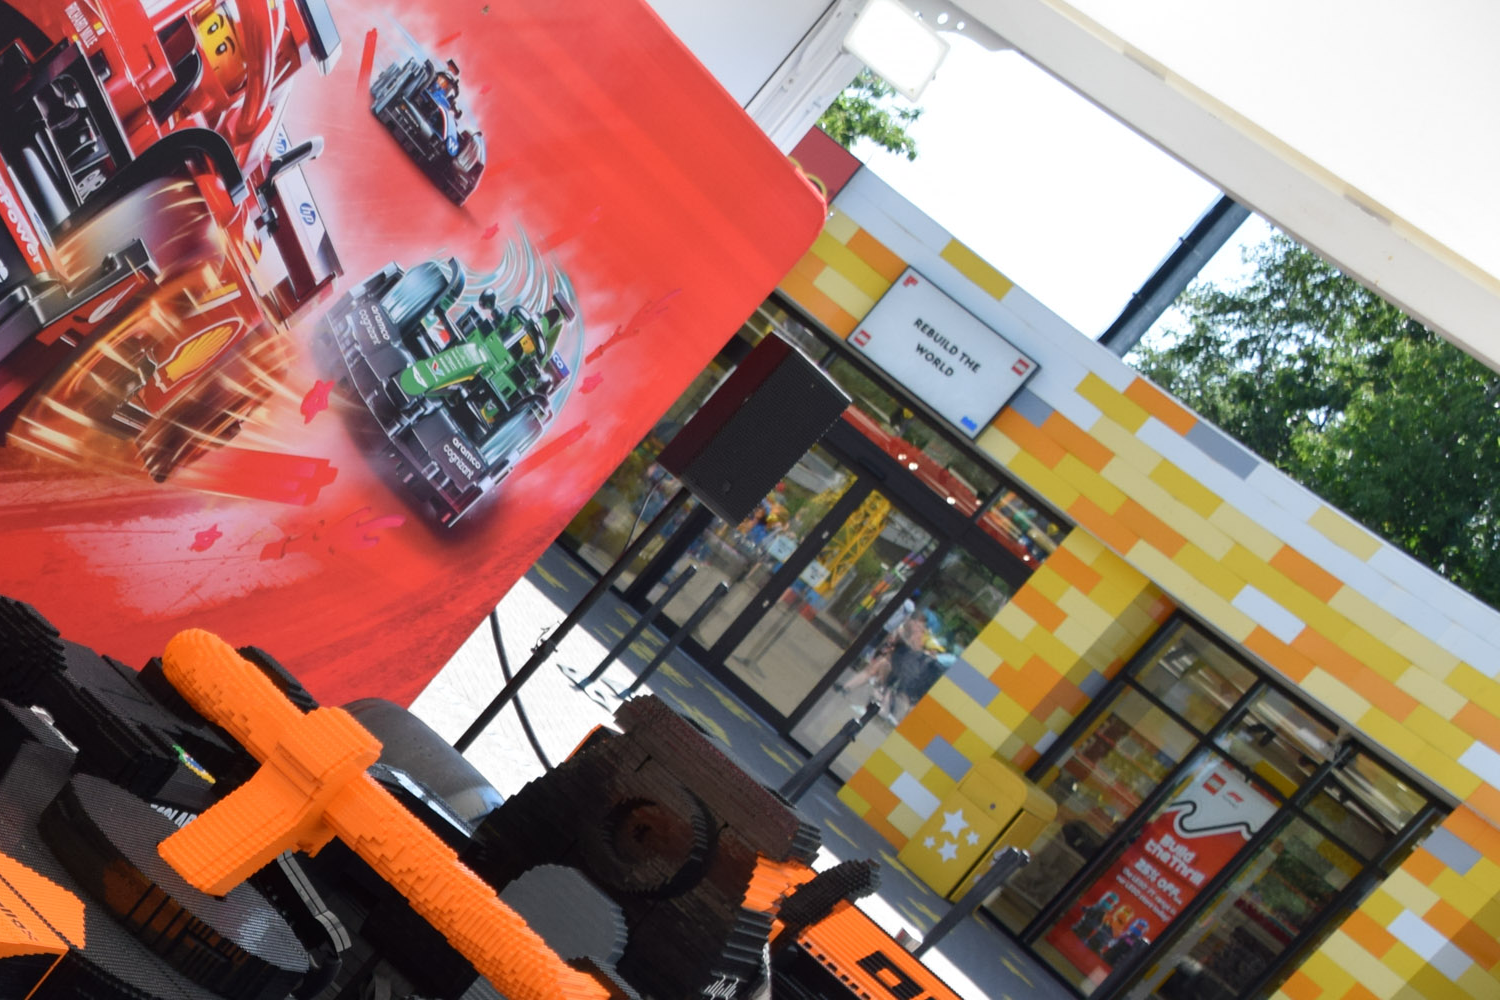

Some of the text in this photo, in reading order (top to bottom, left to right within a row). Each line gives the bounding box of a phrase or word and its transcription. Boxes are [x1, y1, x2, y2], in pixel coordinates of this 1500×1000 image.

[358, 308, 382, 346] cognizant
[370, 304, 391, 341] aramco
[913, 317, 982, 374] REBUILD THE
[915, 342, 955, 377] WORLD
[442, 443, 475, 481] cognizant
[451, 435, 482, 471] aramco
